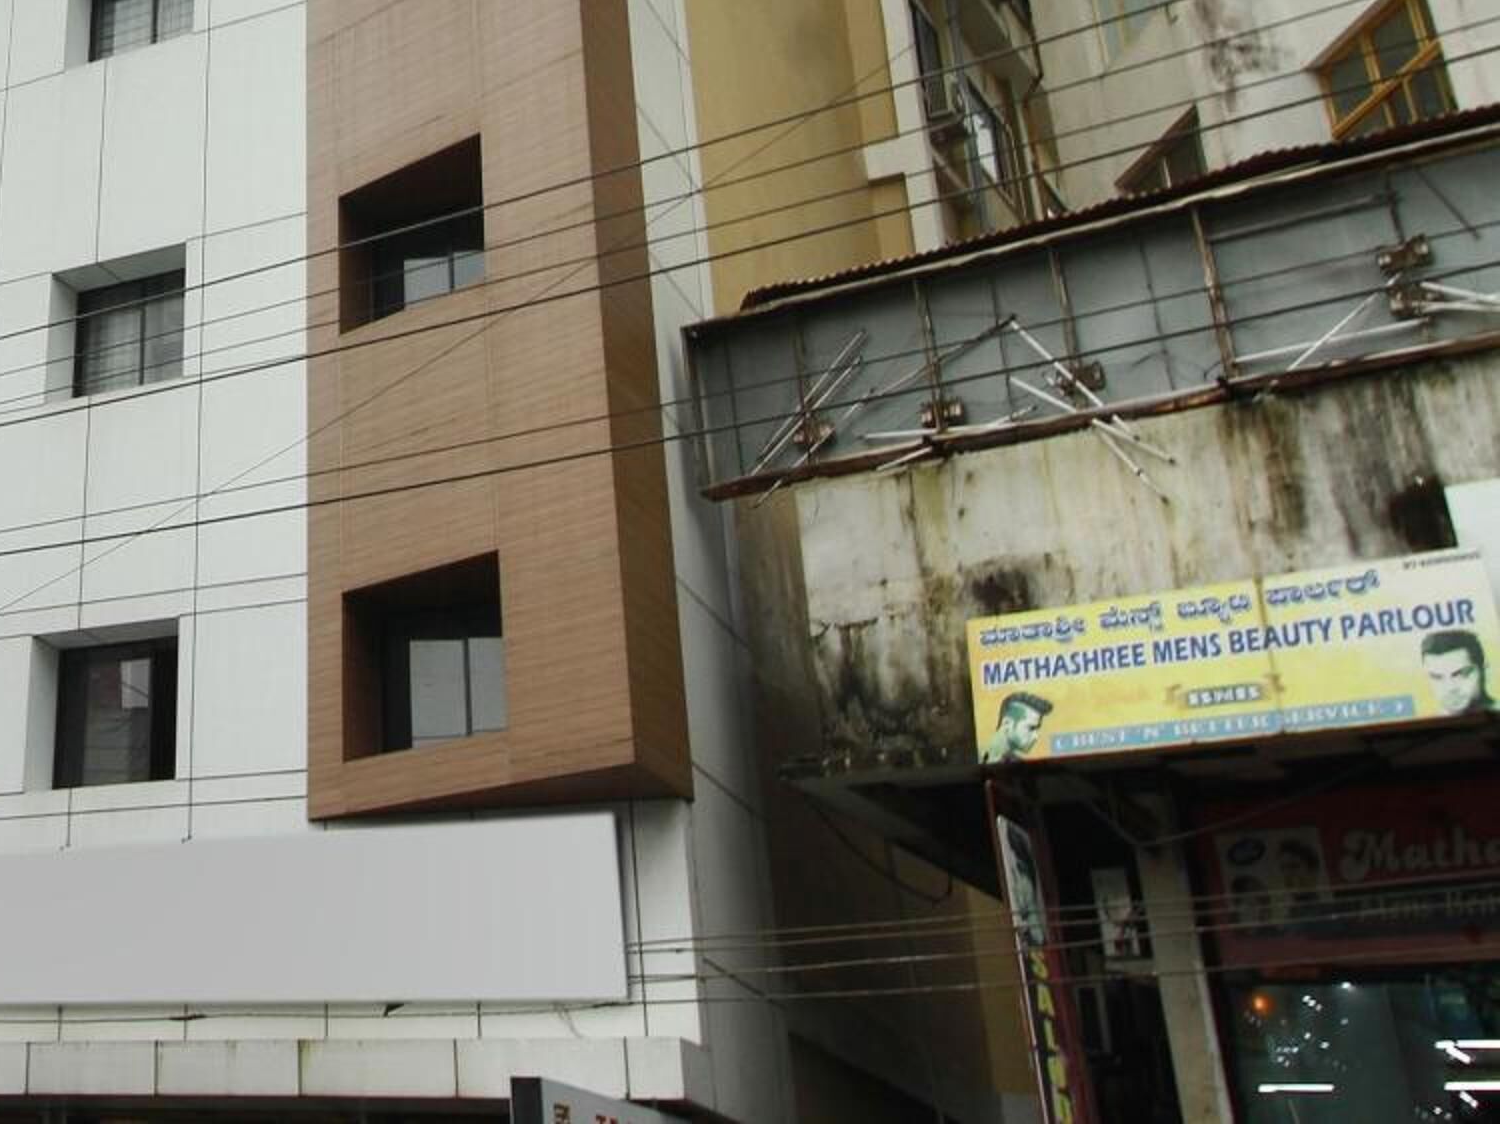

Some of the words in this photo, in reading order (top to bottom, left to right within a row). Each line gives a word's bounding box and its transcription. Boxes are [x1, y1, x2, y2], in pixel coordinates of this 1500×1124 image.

[982, 643, 1146, 686] MATHASHREE
[1152, 632, 1222, 665] MENS
[1228, 617, 1332, 654] BEAUTY
[1340, 598, 1475, 640] PARLOUR
